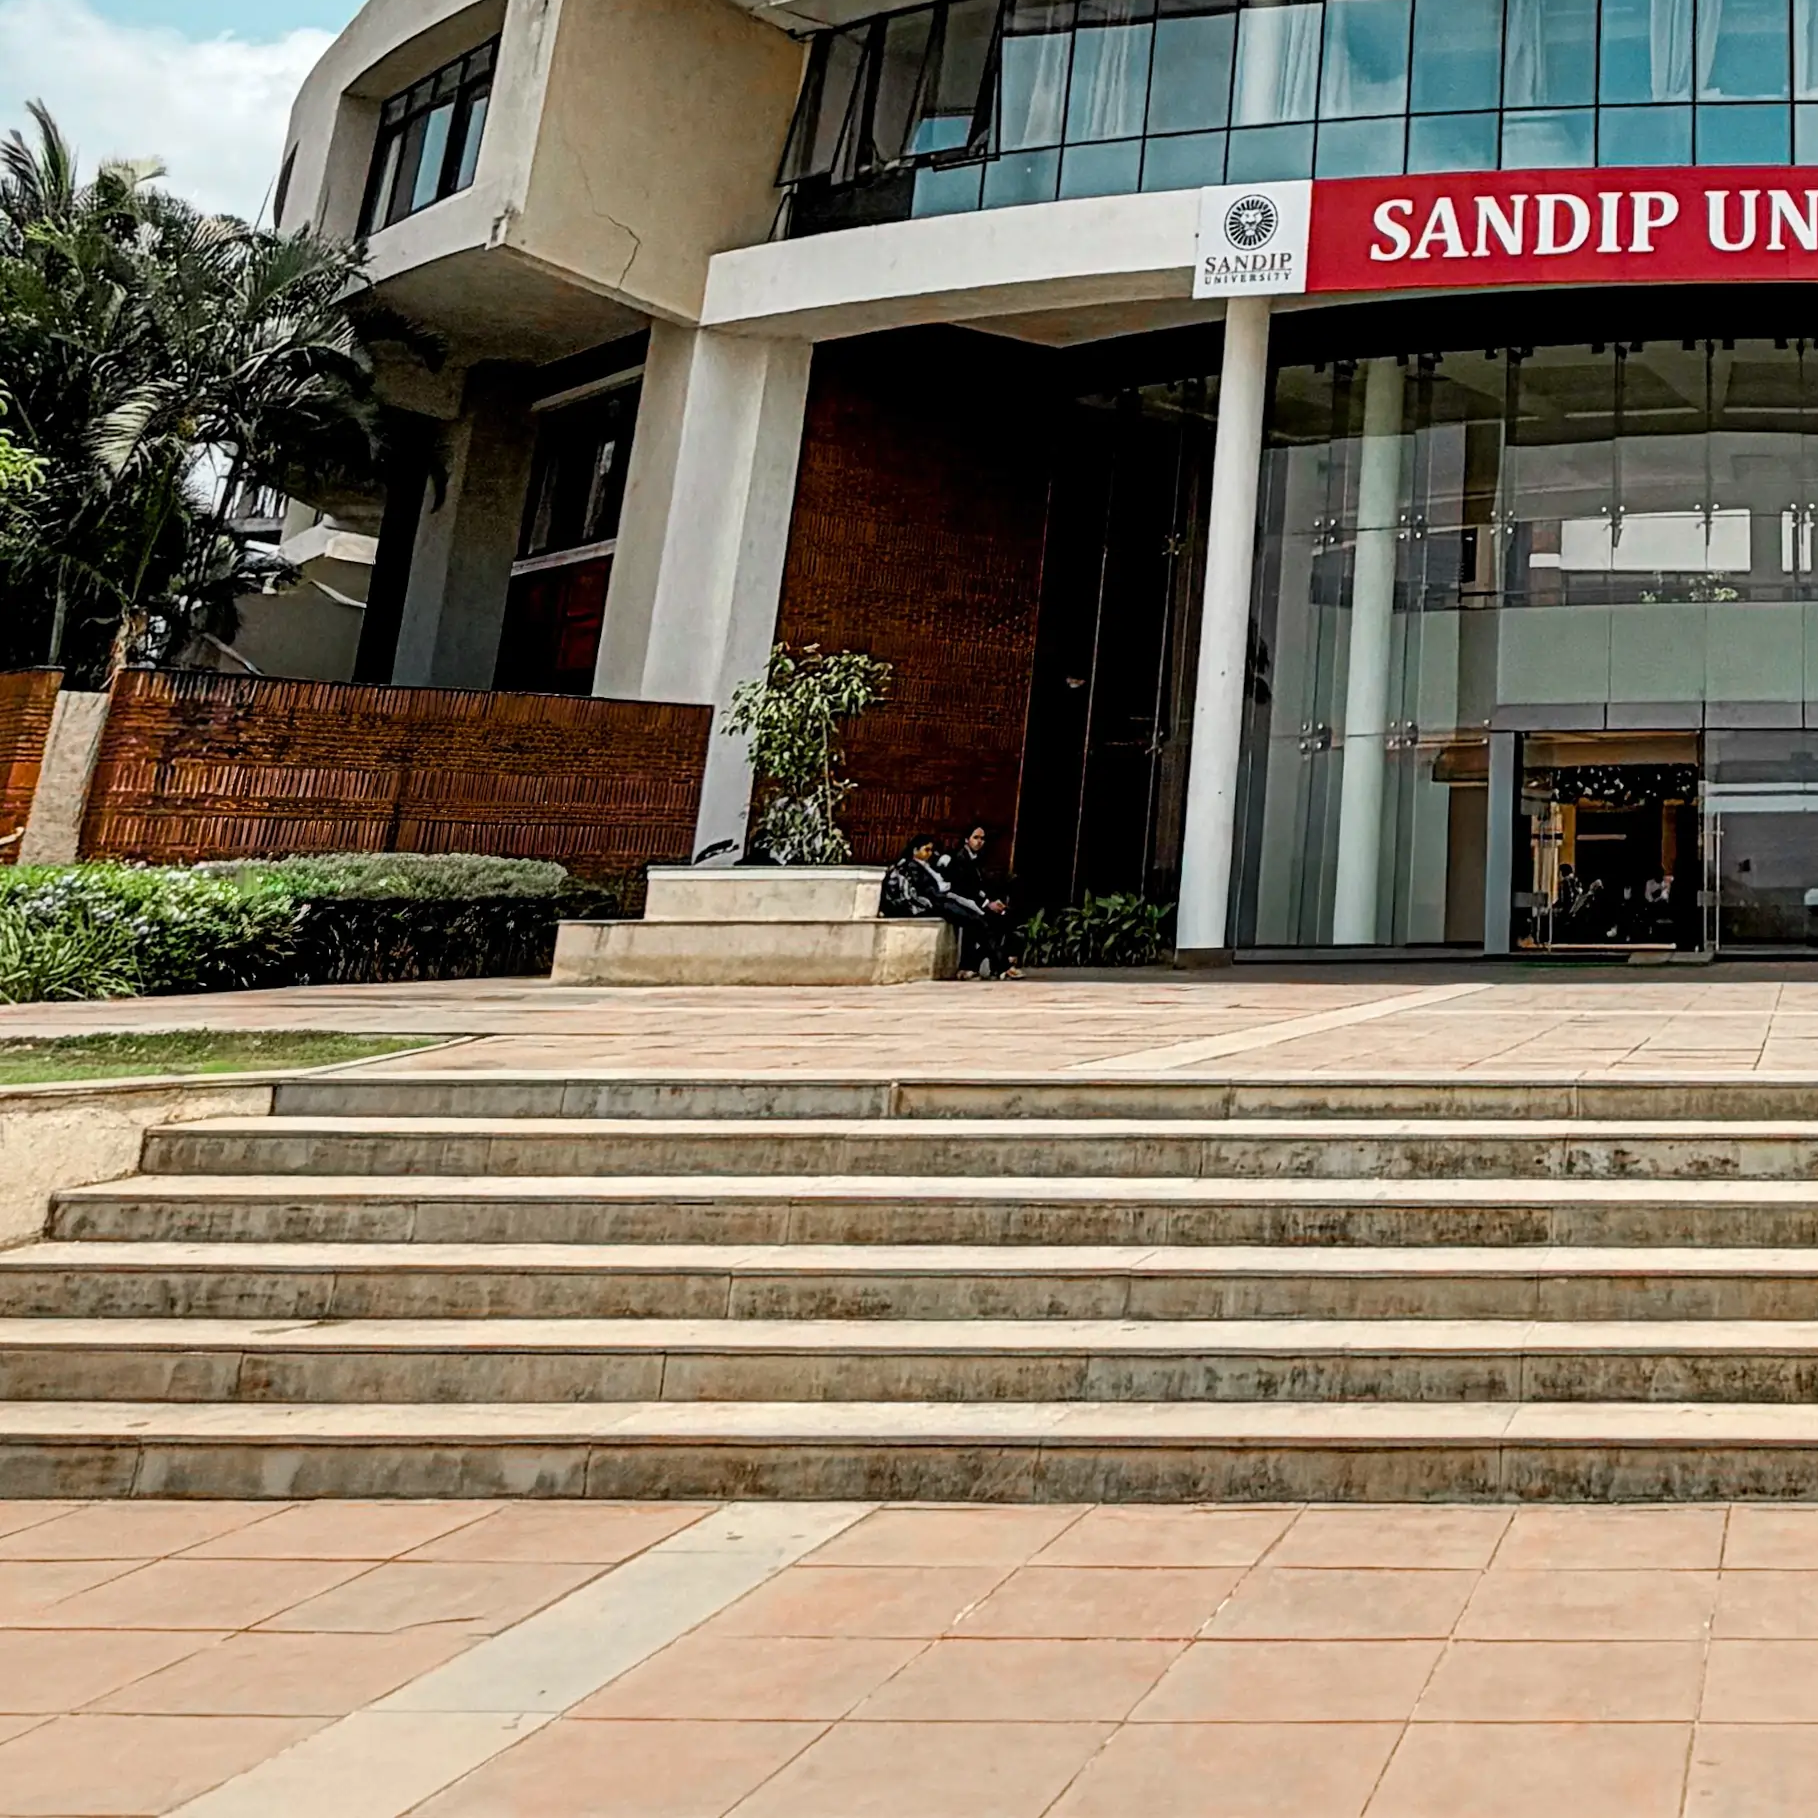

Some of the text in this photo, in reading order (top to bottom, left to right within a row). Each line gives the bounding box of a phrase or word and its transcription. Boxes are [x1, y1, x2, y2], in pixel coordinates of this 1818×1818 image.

[1370, 191, 1679, 262] SANDIP
[1204, 252, 1292, 274] SANDIP
[1204, 272, 1292, 285] UNIVERSITY
